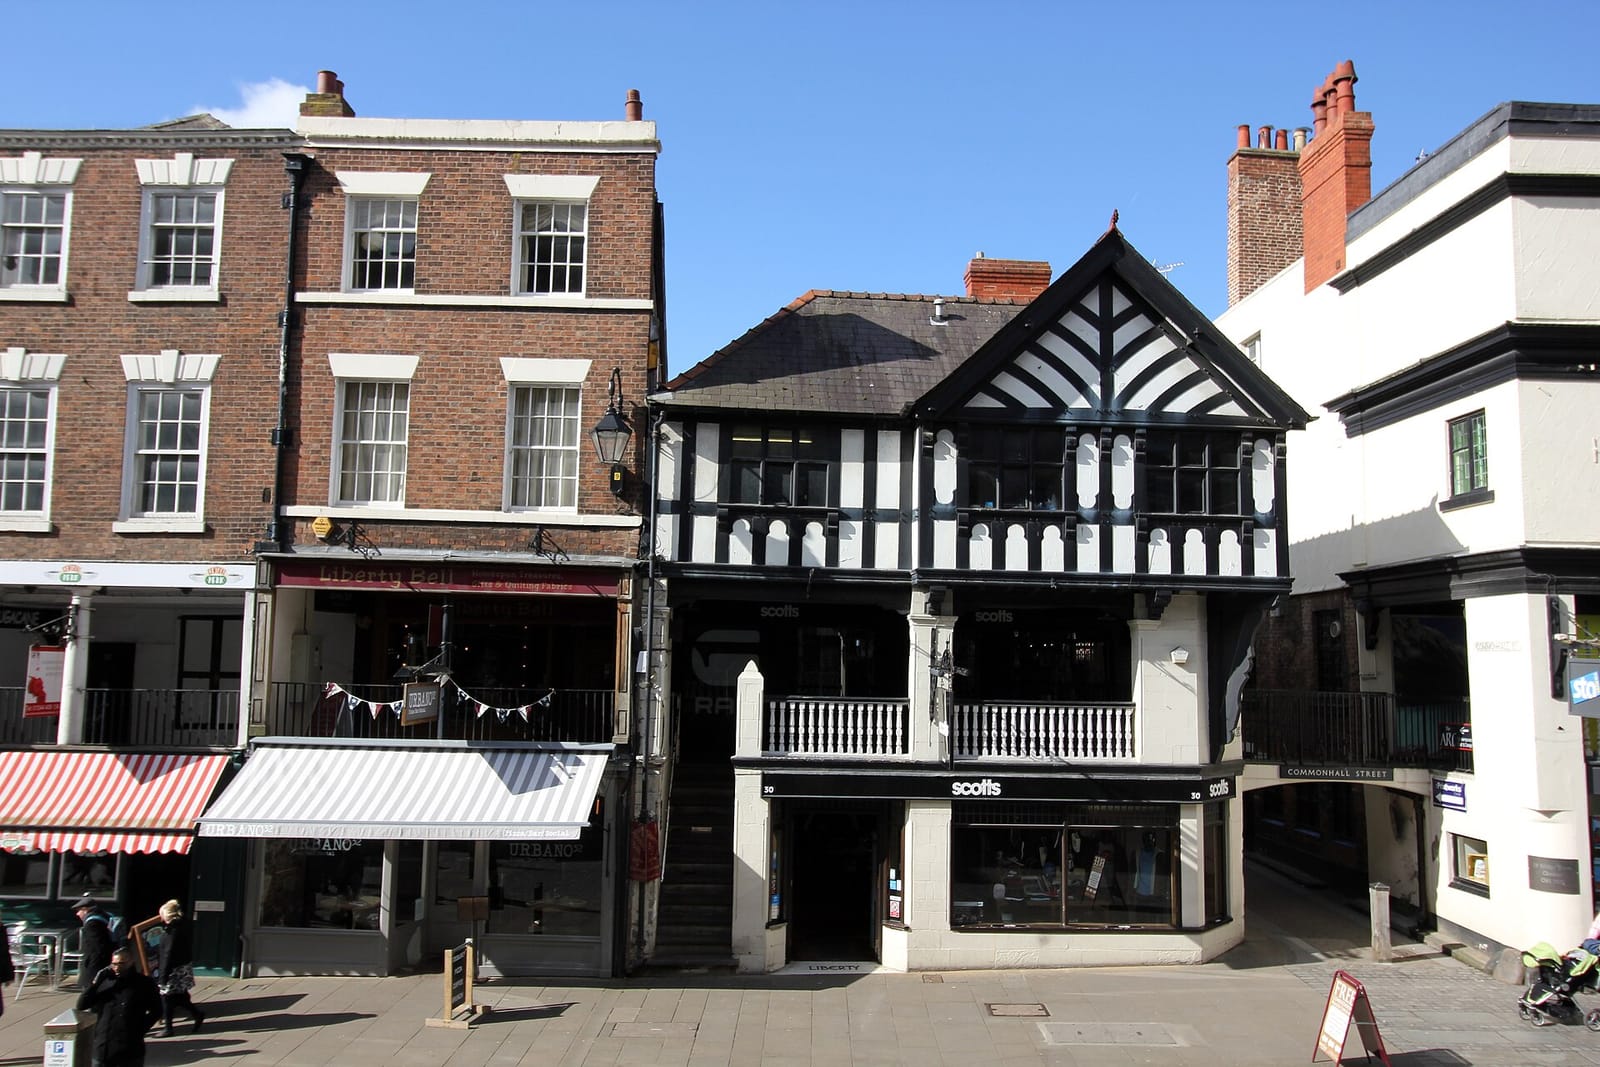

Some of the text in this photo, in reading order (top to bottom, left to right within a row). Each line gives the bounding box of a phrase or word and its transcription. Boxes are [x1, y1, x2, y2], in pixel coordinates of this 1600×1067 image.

[320, 565, 454, 589] Liberty Bell
[760, 604, 800, 618] scotts
[975, 609, 1014, 622] scotts
[1287, 768, 1388, 778] COMMONHALL STREET
[763, 785, 775, 793] 30
[951, 778, 1002, 796] scotts
[1209, 779, 1229, 798] scotts
[1190, 791, 1201, 800] 30
